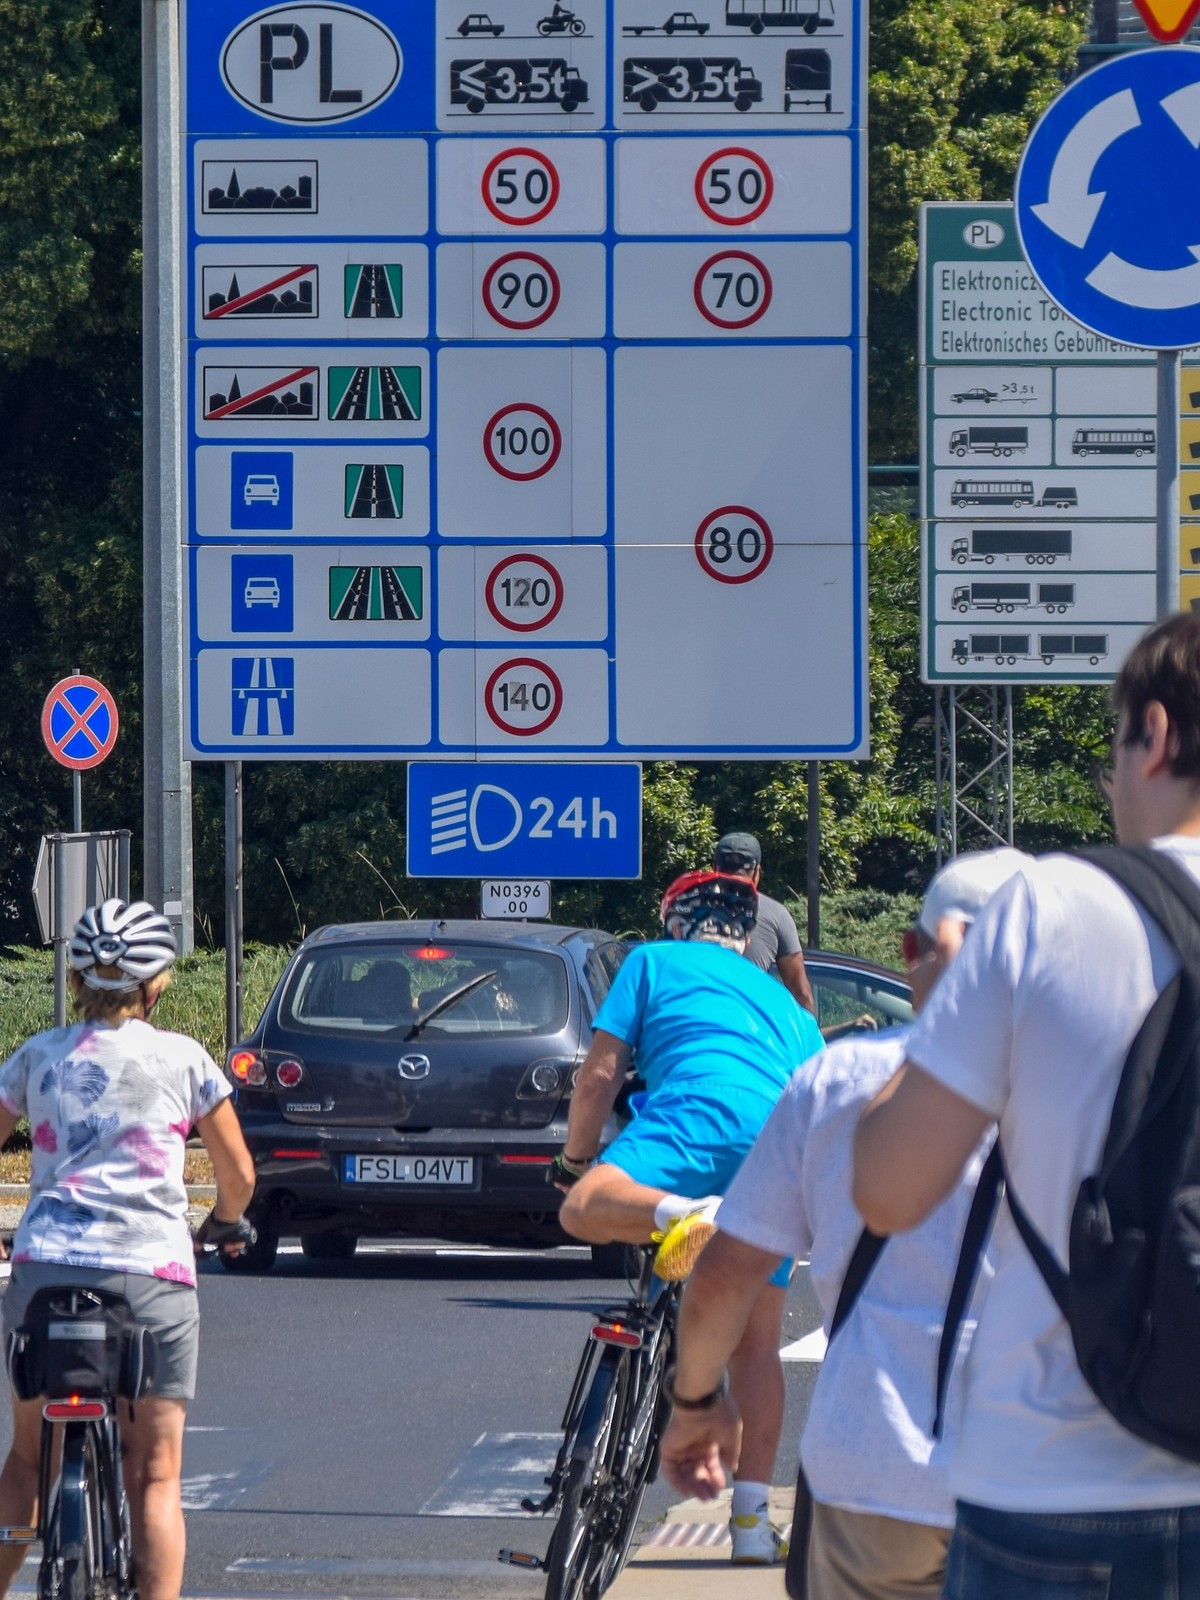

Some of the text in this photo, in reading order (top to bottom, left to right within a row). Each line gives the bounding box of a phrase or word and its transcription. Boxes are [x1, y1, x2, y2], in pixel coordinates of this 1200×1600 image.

[259, 22, 363, 104] PL
[495, 168, 549, 205] 50
[707, 168, 762, 205] 50
[970, 224, 996, 244] PL
[497, 272, 549, 309] 90
[712, 272, 760, 308] 70
[941, 269, 1043, 291] Elektronicz
[941, 300, 1032, 321] Electronic
[941, 330, 1048, 352] Elektronisches
[495, 426, 551, 457] 100
[708, 527, 761, 564] 80
[500, 577, 551, 608] 120
[497, 681, 552, 713] 140
[529, 797, 617, 839] 24h
[490, 885, 541, 898] N0396
[359, 1158, 469, 1181] FSL 04VT
